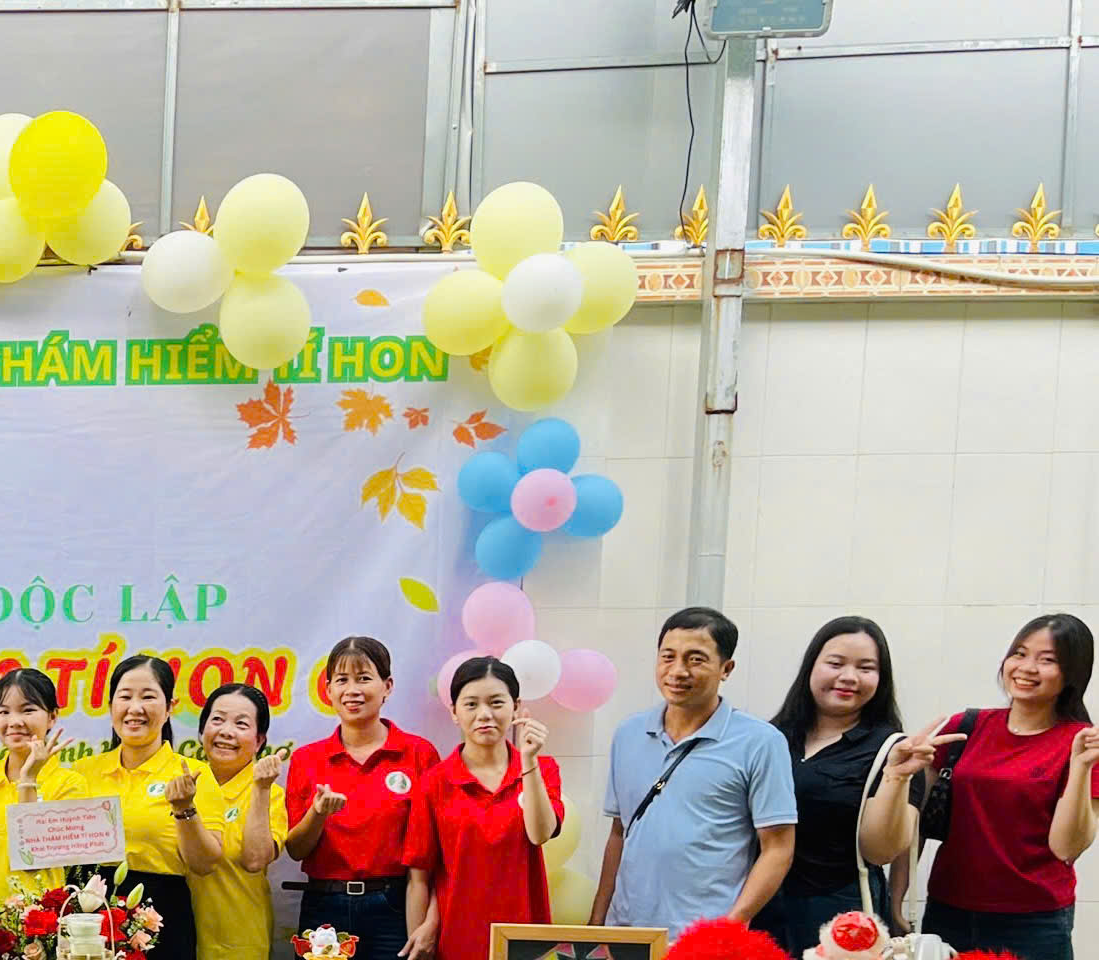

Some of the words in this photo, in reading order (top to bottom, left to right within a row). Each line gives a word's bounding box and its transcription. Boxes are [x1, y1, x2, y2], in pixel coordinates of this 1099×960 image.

[126, 324, 257, 385] HIỂM
[329, 337, 447, 382] HON
[118, 574, 228, 629] LẬP
[46, 642, 117, 708] TÍ
